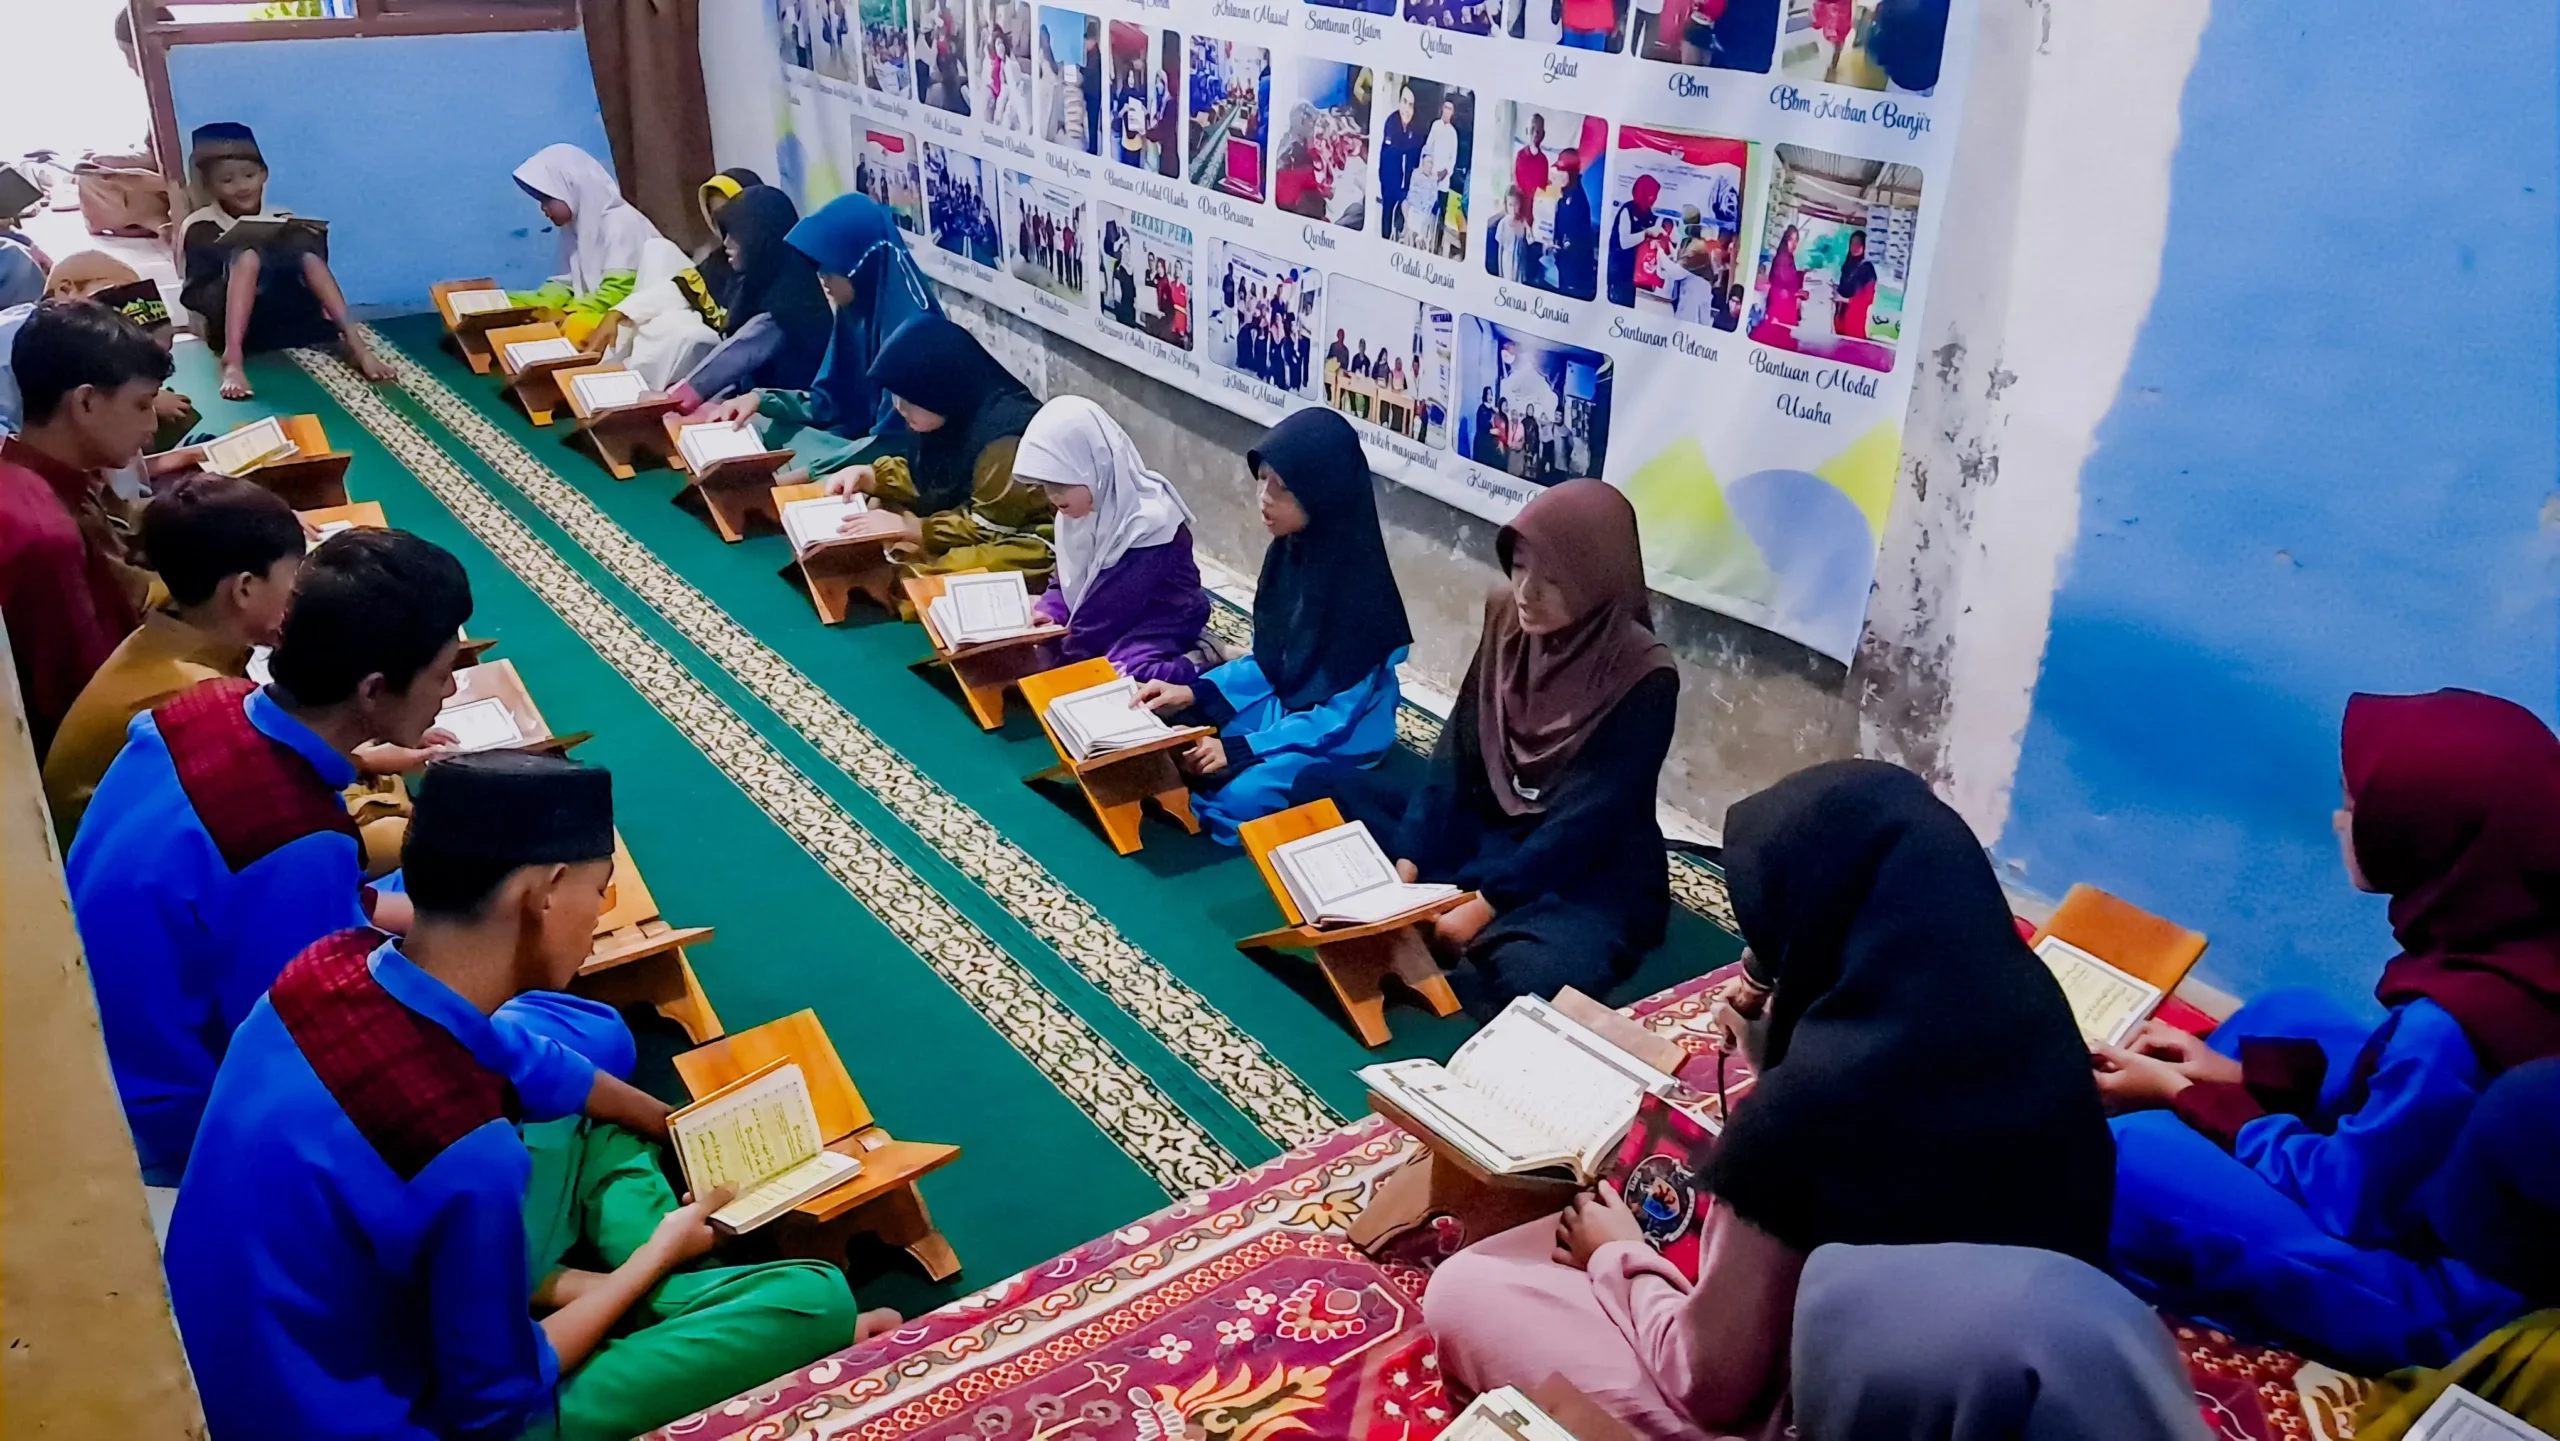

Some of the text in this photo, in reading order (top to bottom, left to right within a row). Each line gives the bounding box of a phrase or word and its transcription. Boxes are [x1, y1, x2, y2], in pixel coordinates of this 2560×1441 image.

[1305, 10, 1382, 45] Santunan Yatim
[1420, 30, 1453, 59] Qurban
[1543, 52, 1578, 83] Zakat
[1669, 72, 1709, 98] Bbm
[1770, 84, 1932, 141] Bbm Korban Banjir
[1219, 202, 1254, 228] Bersama
[1303, 224, 1335, 251] Qurban
[1391, 251, 1455, 289] Peduli Lansia
[1495, 286, 1570, 324] Saras Lansia
[1609, 316, 1718, 361] Santunan Veteran
[1749, 348, 1879, 399] Bantuan Modal
[1777, 393, 1831, 425] Usaha
[1467, 468, 1523, 506] Kunjungan
